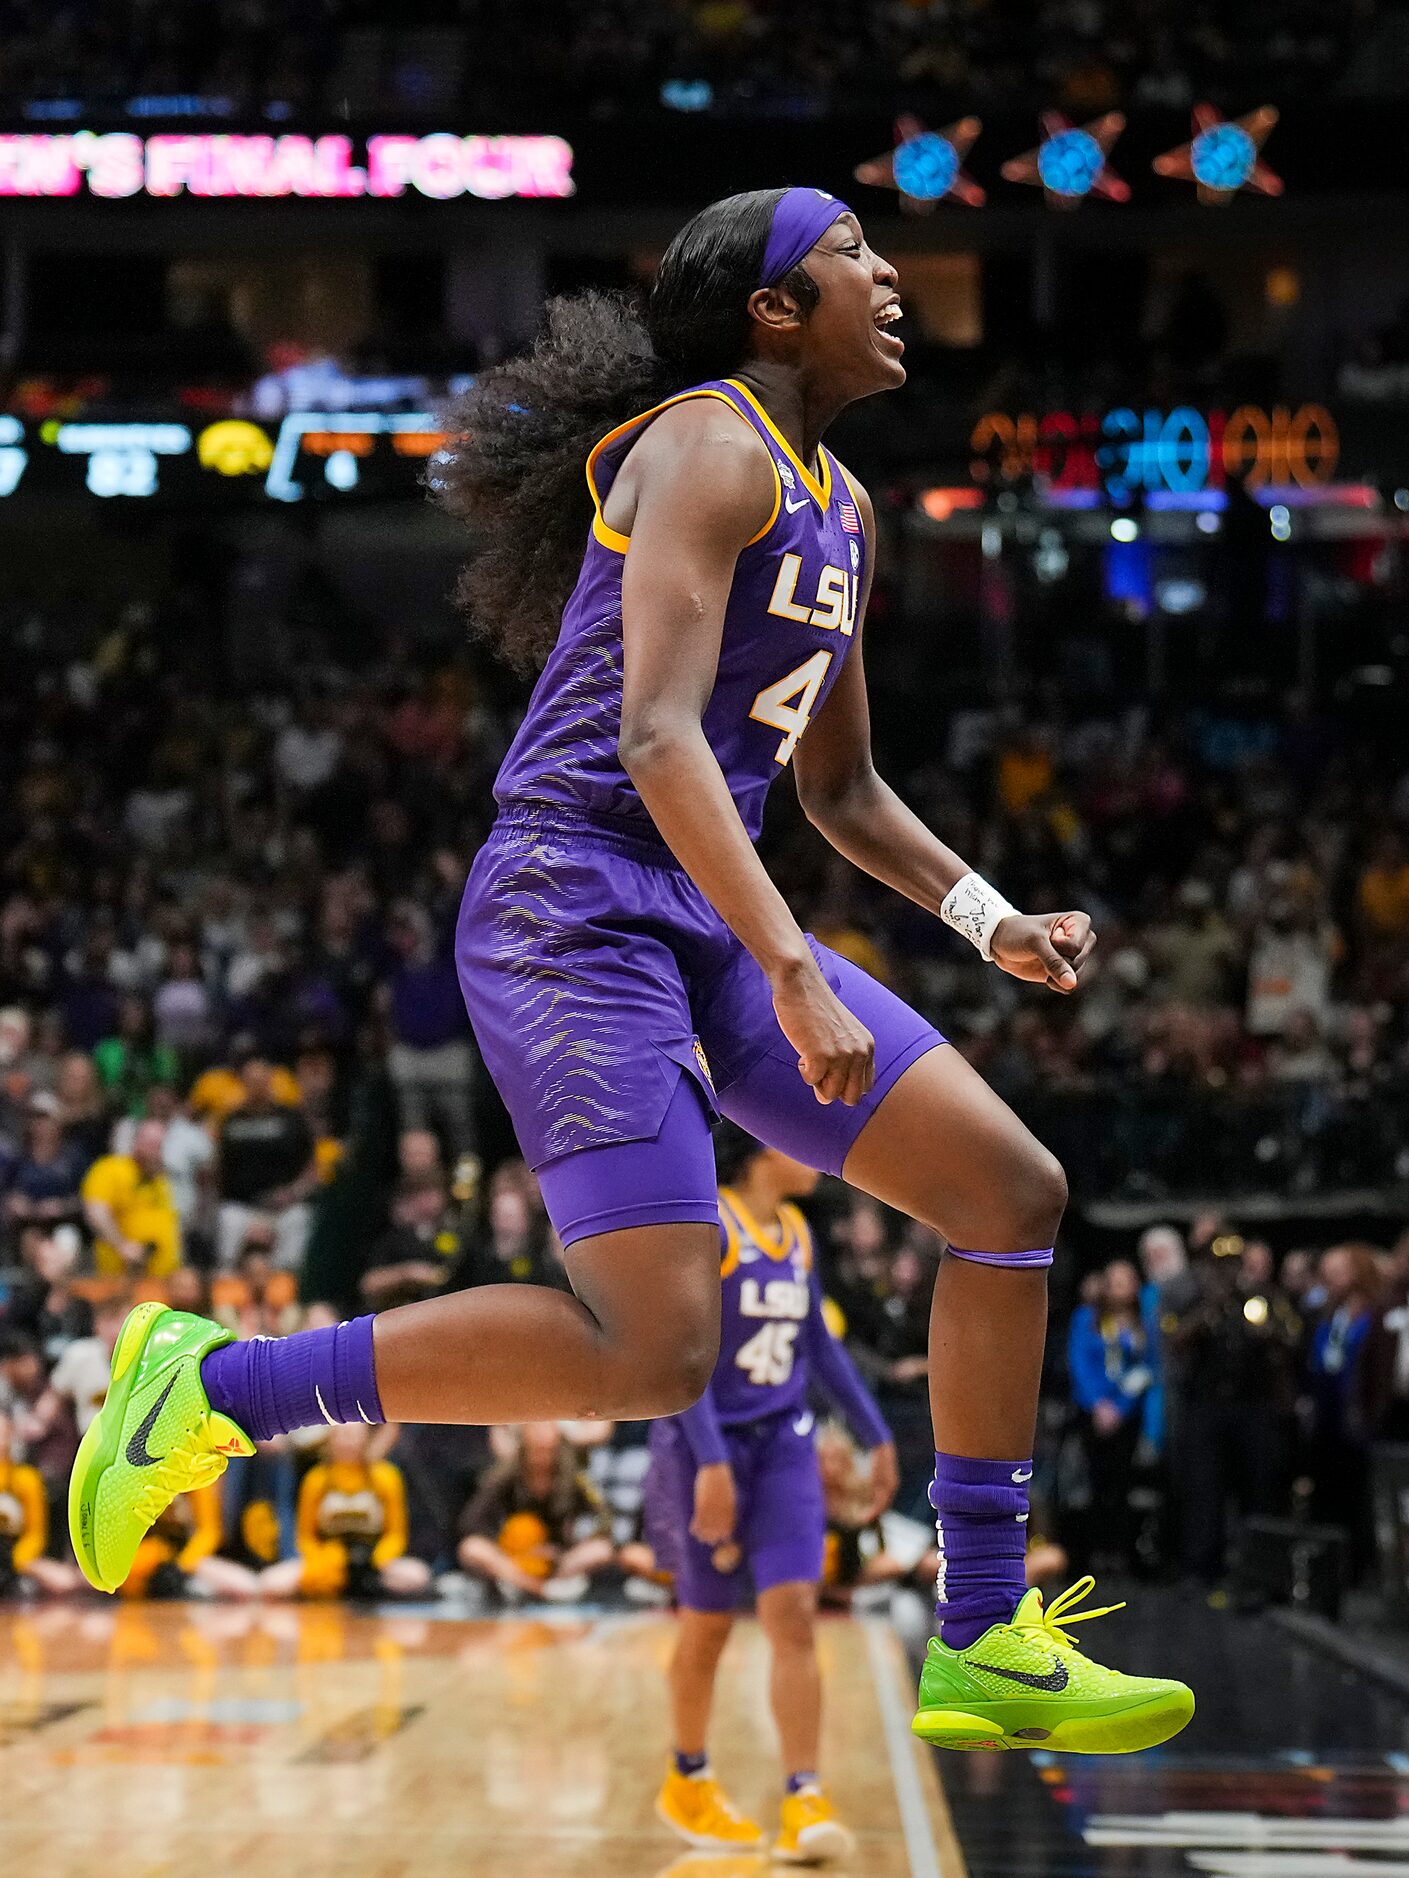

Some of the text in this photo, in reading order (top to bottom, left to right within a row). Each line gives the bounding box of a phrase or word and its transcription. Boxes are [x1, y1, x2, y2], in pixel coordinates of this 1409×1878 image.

[145, 133, 368, 197] FINAL
[369, 133, 577, 199] FOUR
[767, 553, 859, 637] LSU
[748, 649, 833, 767] 4
[740, 1278, 810, 1320] LSU
[734, 1321, 800, 1386] 45
